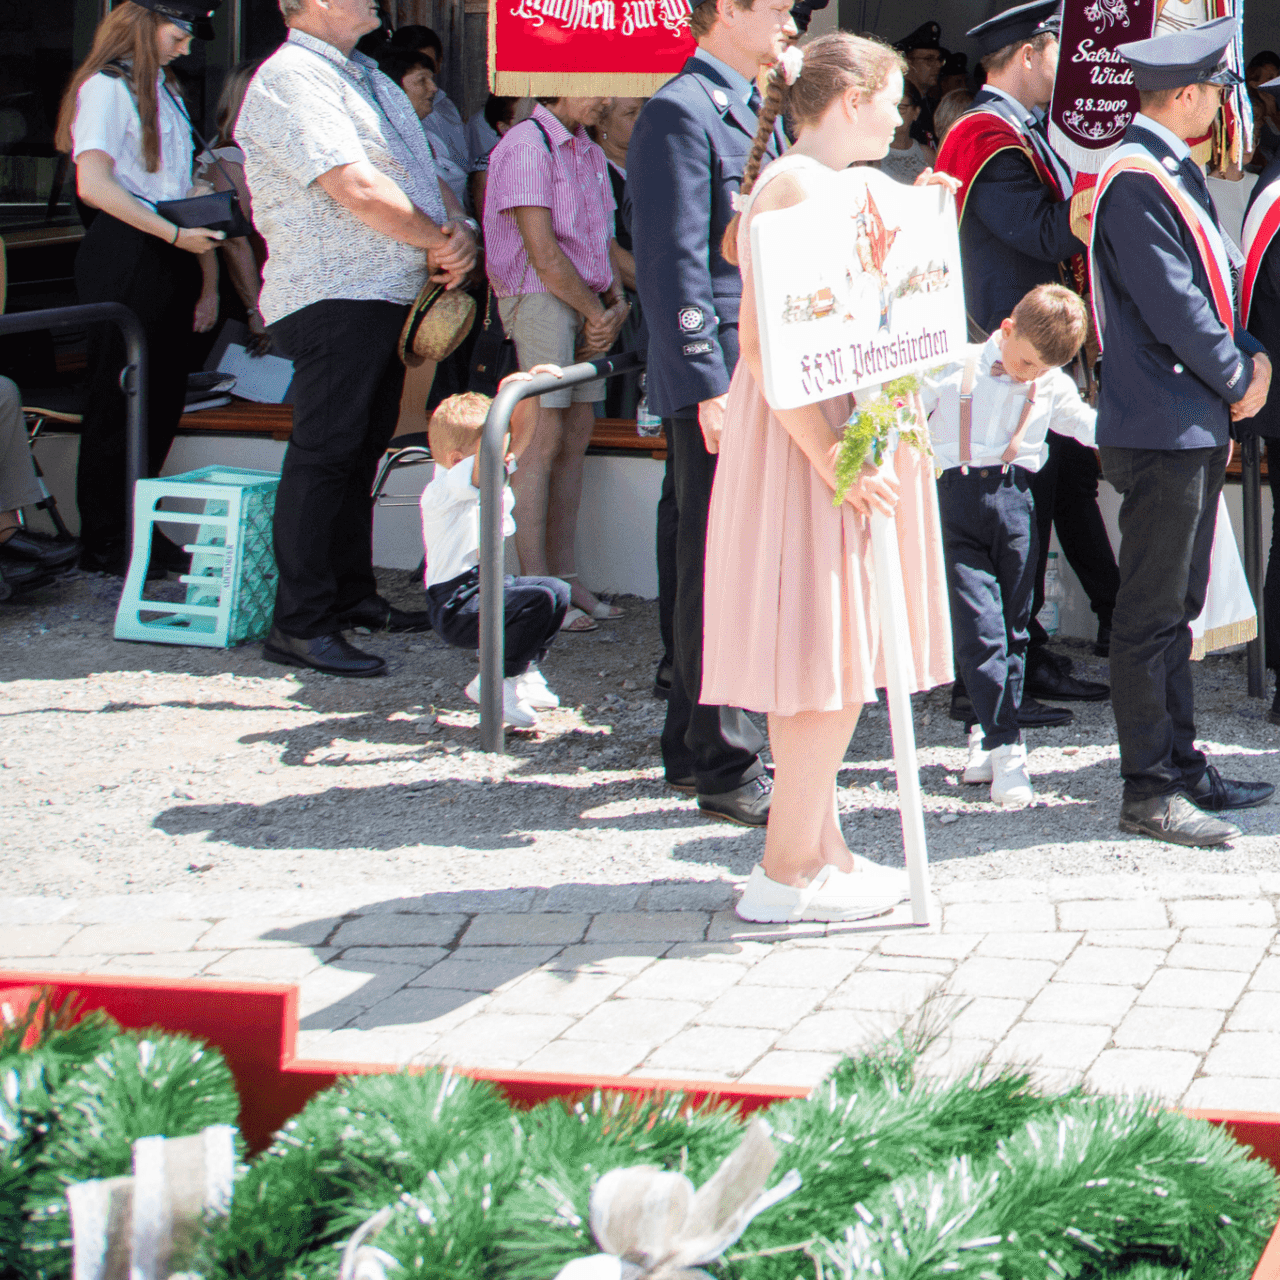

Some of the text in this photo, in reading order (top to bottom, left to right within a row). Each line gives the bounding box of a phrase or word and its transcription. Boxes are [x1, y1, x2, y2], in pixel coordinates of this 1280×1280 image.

[621, 0, 658, 36] zur
[1074, 98, 1128, 112] 9.8.2009
[849, 327, 949, 385] Peterskirchen
